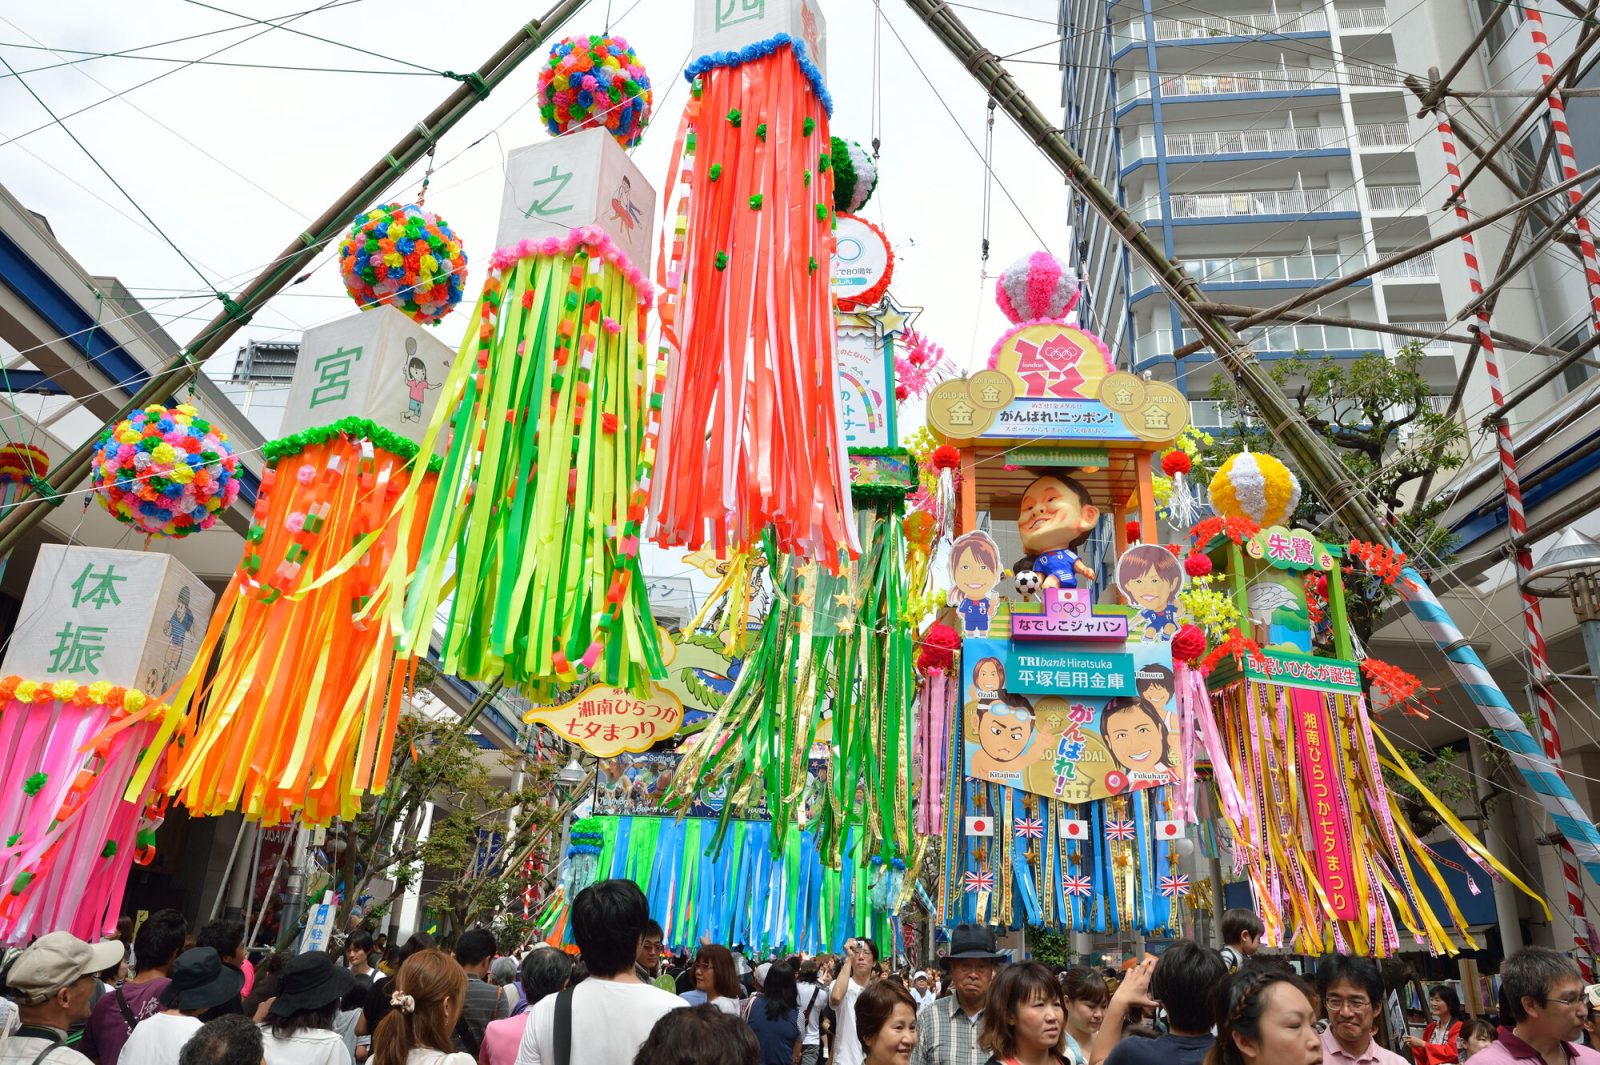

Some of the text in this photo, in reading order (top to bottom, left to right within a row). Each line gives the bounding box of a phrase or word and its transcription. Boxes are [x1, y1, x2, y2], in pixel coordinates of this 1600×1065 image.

[524, 165, 574, 219] 之
[309, 346, 363, 409] 宮
[982, 385, 1001, 402] 金
[1113, 388, 1133, 405] 金
[1152, 396, 1177, 404] MEDAL
[947, 401, 976, 425] 金
[1140, 404, 1171, 430] 金
[1010, 450, 1105, 463] Sawa Homare
[1268, 534, 1314, 564] 朱鷺
[1321, 555, 1331, 567] き
[47, 562, 128, 675] 体振
[1018, 618, 1122, 633] なでしこジャパン
[1067, 659, 1112, 669] Hiratsuka
[1247, 654, 1358, 686] 可愛いひなが誕生
[1018, 670, 1125, 690] 平塚信用金庫
[578, 698, 678, 723] 湘南ひらつか
[566, 718, 656, 742] 七夕まつり
[1053, 703, 1095, 794] がんばれ!
[989, 771, 1019, 780] Kitajima
[1303, 711, 1346, 911] 湘南ひらつか七夕まつり
